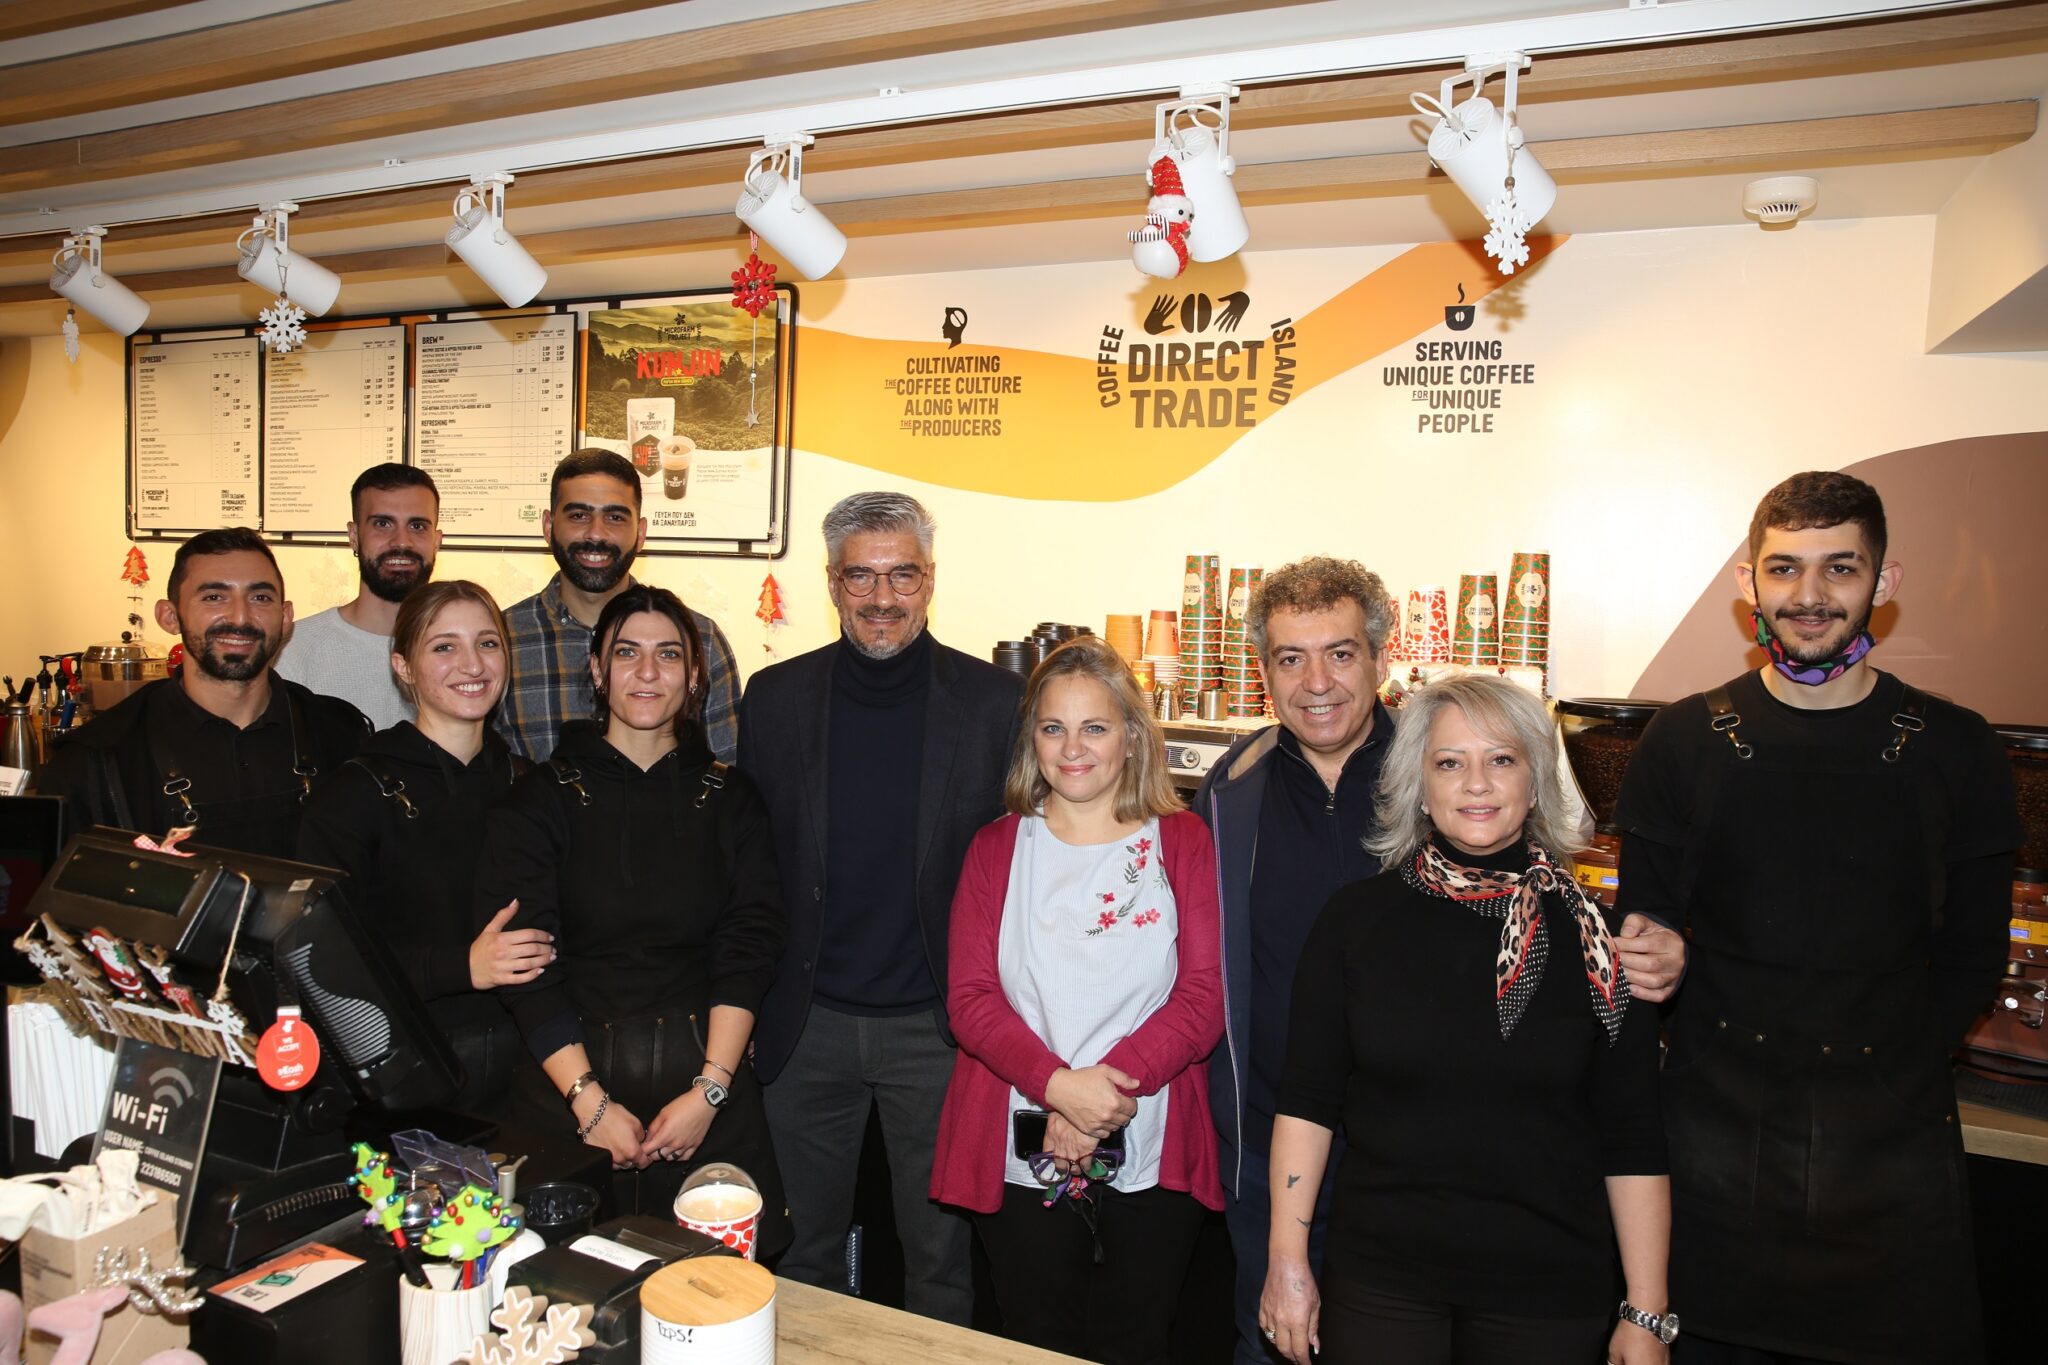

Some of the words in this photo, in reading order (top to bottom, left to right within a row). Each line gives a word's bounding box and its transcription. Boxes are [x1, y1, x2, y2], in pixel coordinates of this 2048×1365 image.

[422, 336, 439, 345] BREW
[667, 333, 691, 341] PROJECT
[1415, 340, 1503, 362] SERVING
[906, 355, 1001, 375] CULTIVATING
[1097, 325, 1124, 409] COFFEE
[1128, 341, 1265, 383] DIRECT
[1268, 317, 1297, 406] ISLAND
[885, 379, 897, 388] THE
[896, 377, 952, 395] COFFEE
[955, 376, 1022, 394] CULTURE
[1383, 365, 1455, 388] UNIQUE
[1460, 364, 1535, 385] COFFEE
[904, 398, 953, 416] ALONG
[957, 397, 999, 415] WITH
[1130, 388, 1258, 429] TRADE
[1412, 390, 1429, 399] FOR
[1429, 389, 1502, 411] UNIQUE
[421, 419, 448, 427] REFRESHING
[900, 419, 912, 428] THE
[912, 418, 1002, 437] PRODUCERS
[1418, 413, 1494, 433] PEOPLE
[684, 511, 695, 519] ΔΕΝ
[112, 1091, 169, 1136] Wi-Fi
[103, 1129, 122, 1147] USER
